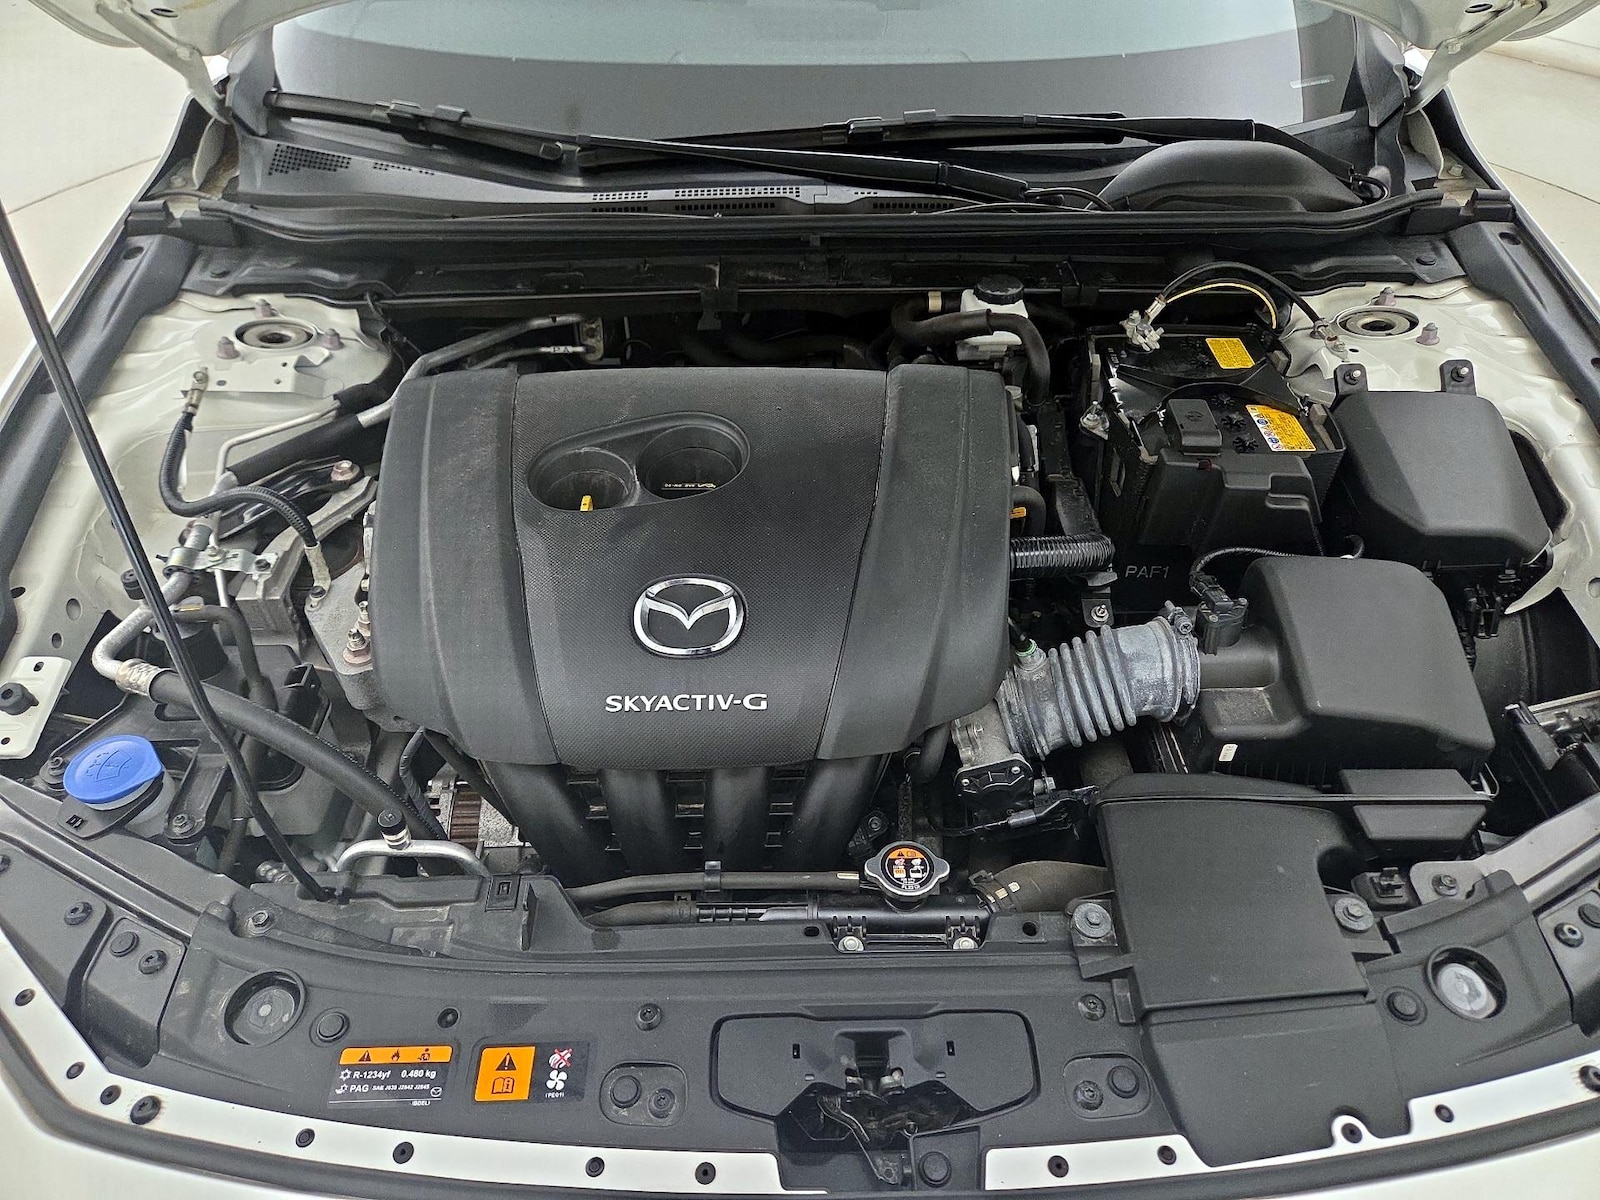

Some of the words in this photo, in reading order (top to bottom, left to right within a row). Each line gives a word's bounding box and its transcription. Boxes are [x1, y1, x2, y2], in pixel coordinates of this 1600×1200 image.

[1125, 565, 1169, 578] PAF1
[605, 693, 768, 712] SKYACTIV-G
[353, 1070, 391, 1080] R-1234yf
[401, 1069, 424, 1078] 0.480
[425, 1069, 437, 1079] kg
[349, 1084, 369, 1092] PAG
